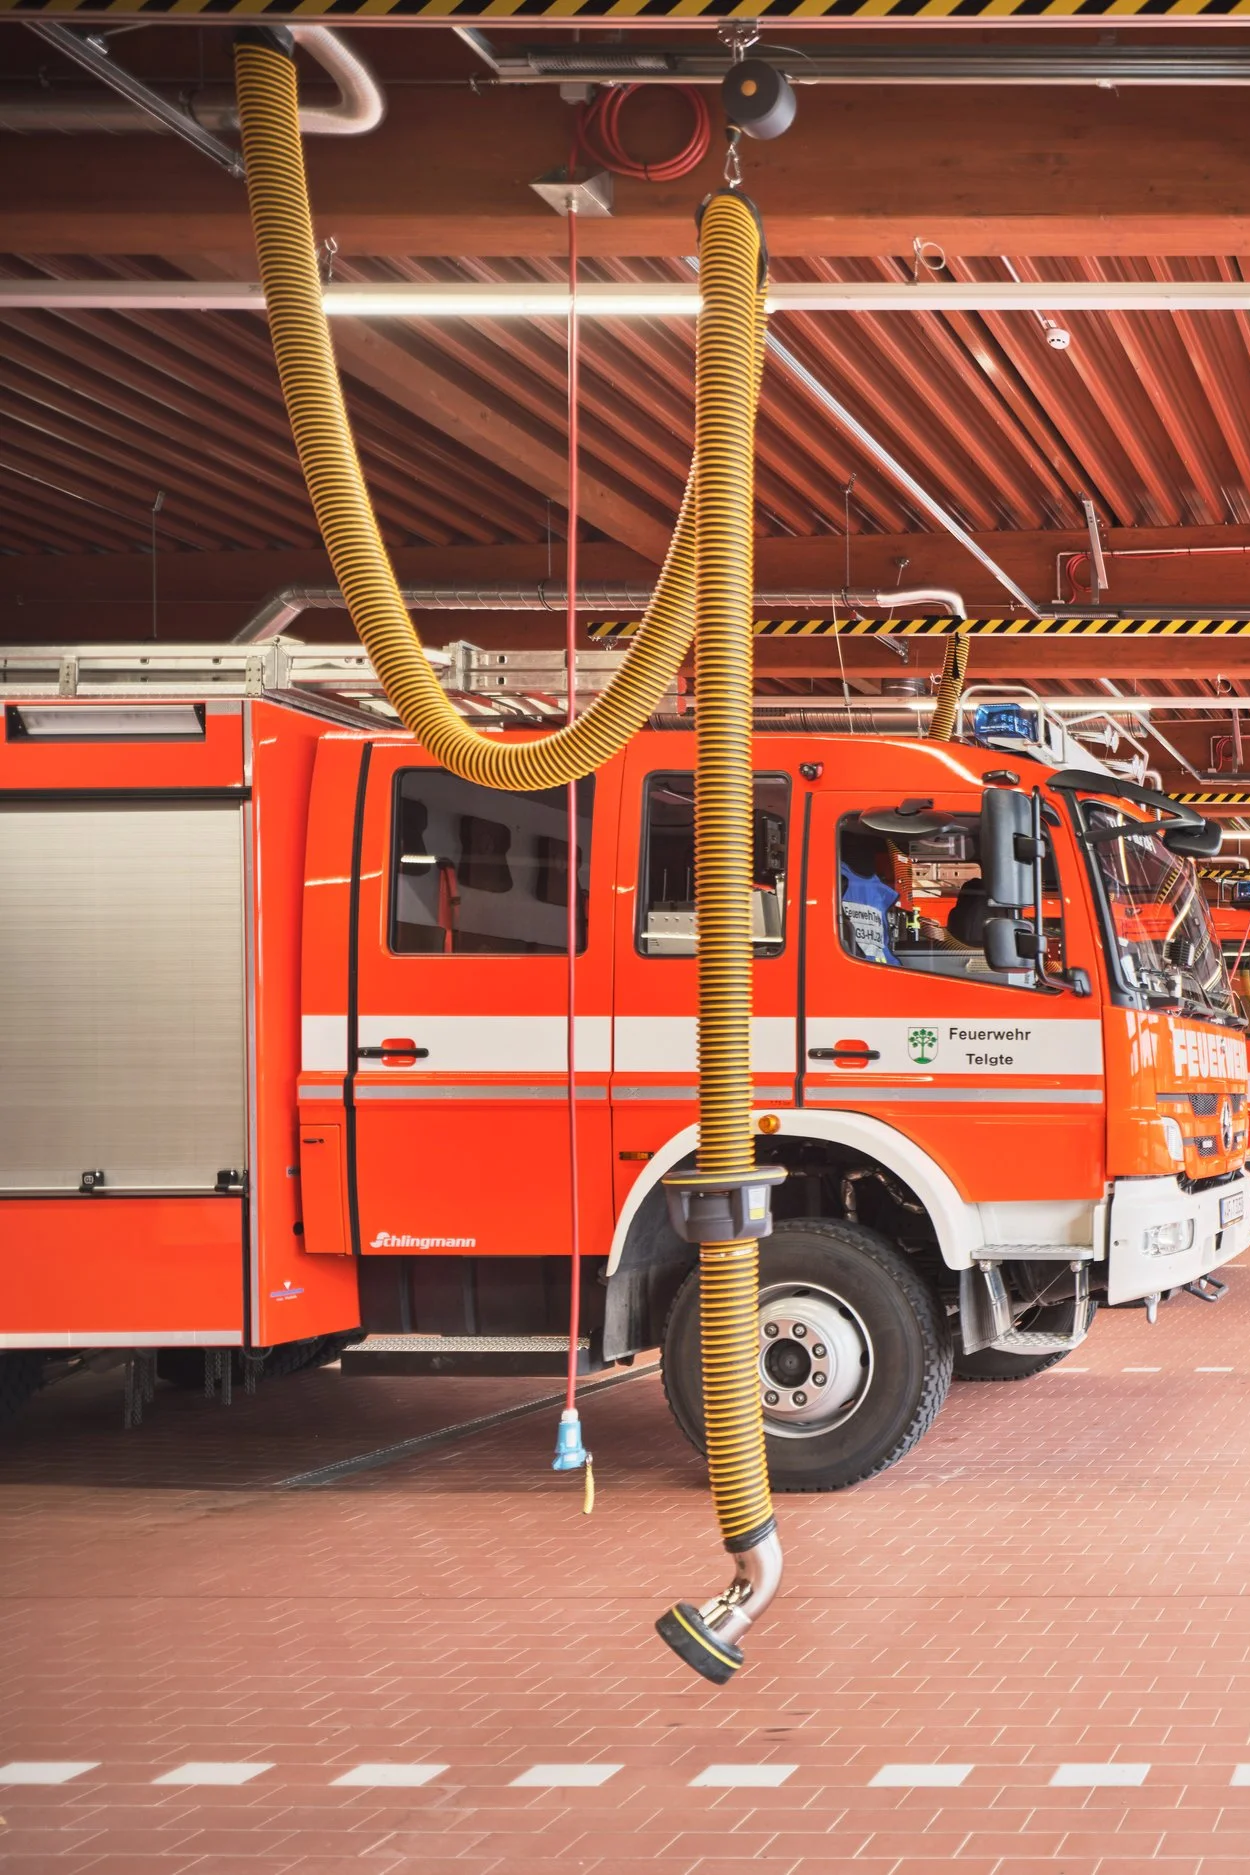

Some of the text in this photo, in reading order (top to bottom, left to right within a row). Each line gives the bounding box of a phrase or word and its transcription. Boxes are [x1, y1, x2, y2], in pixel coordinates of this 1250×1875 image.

[949, 1027, 1031, 1041] Feuerwehr
[965, 1053, 1014, 1067] Telgte
[370, 1231, 477, 1250] Schlingmann
